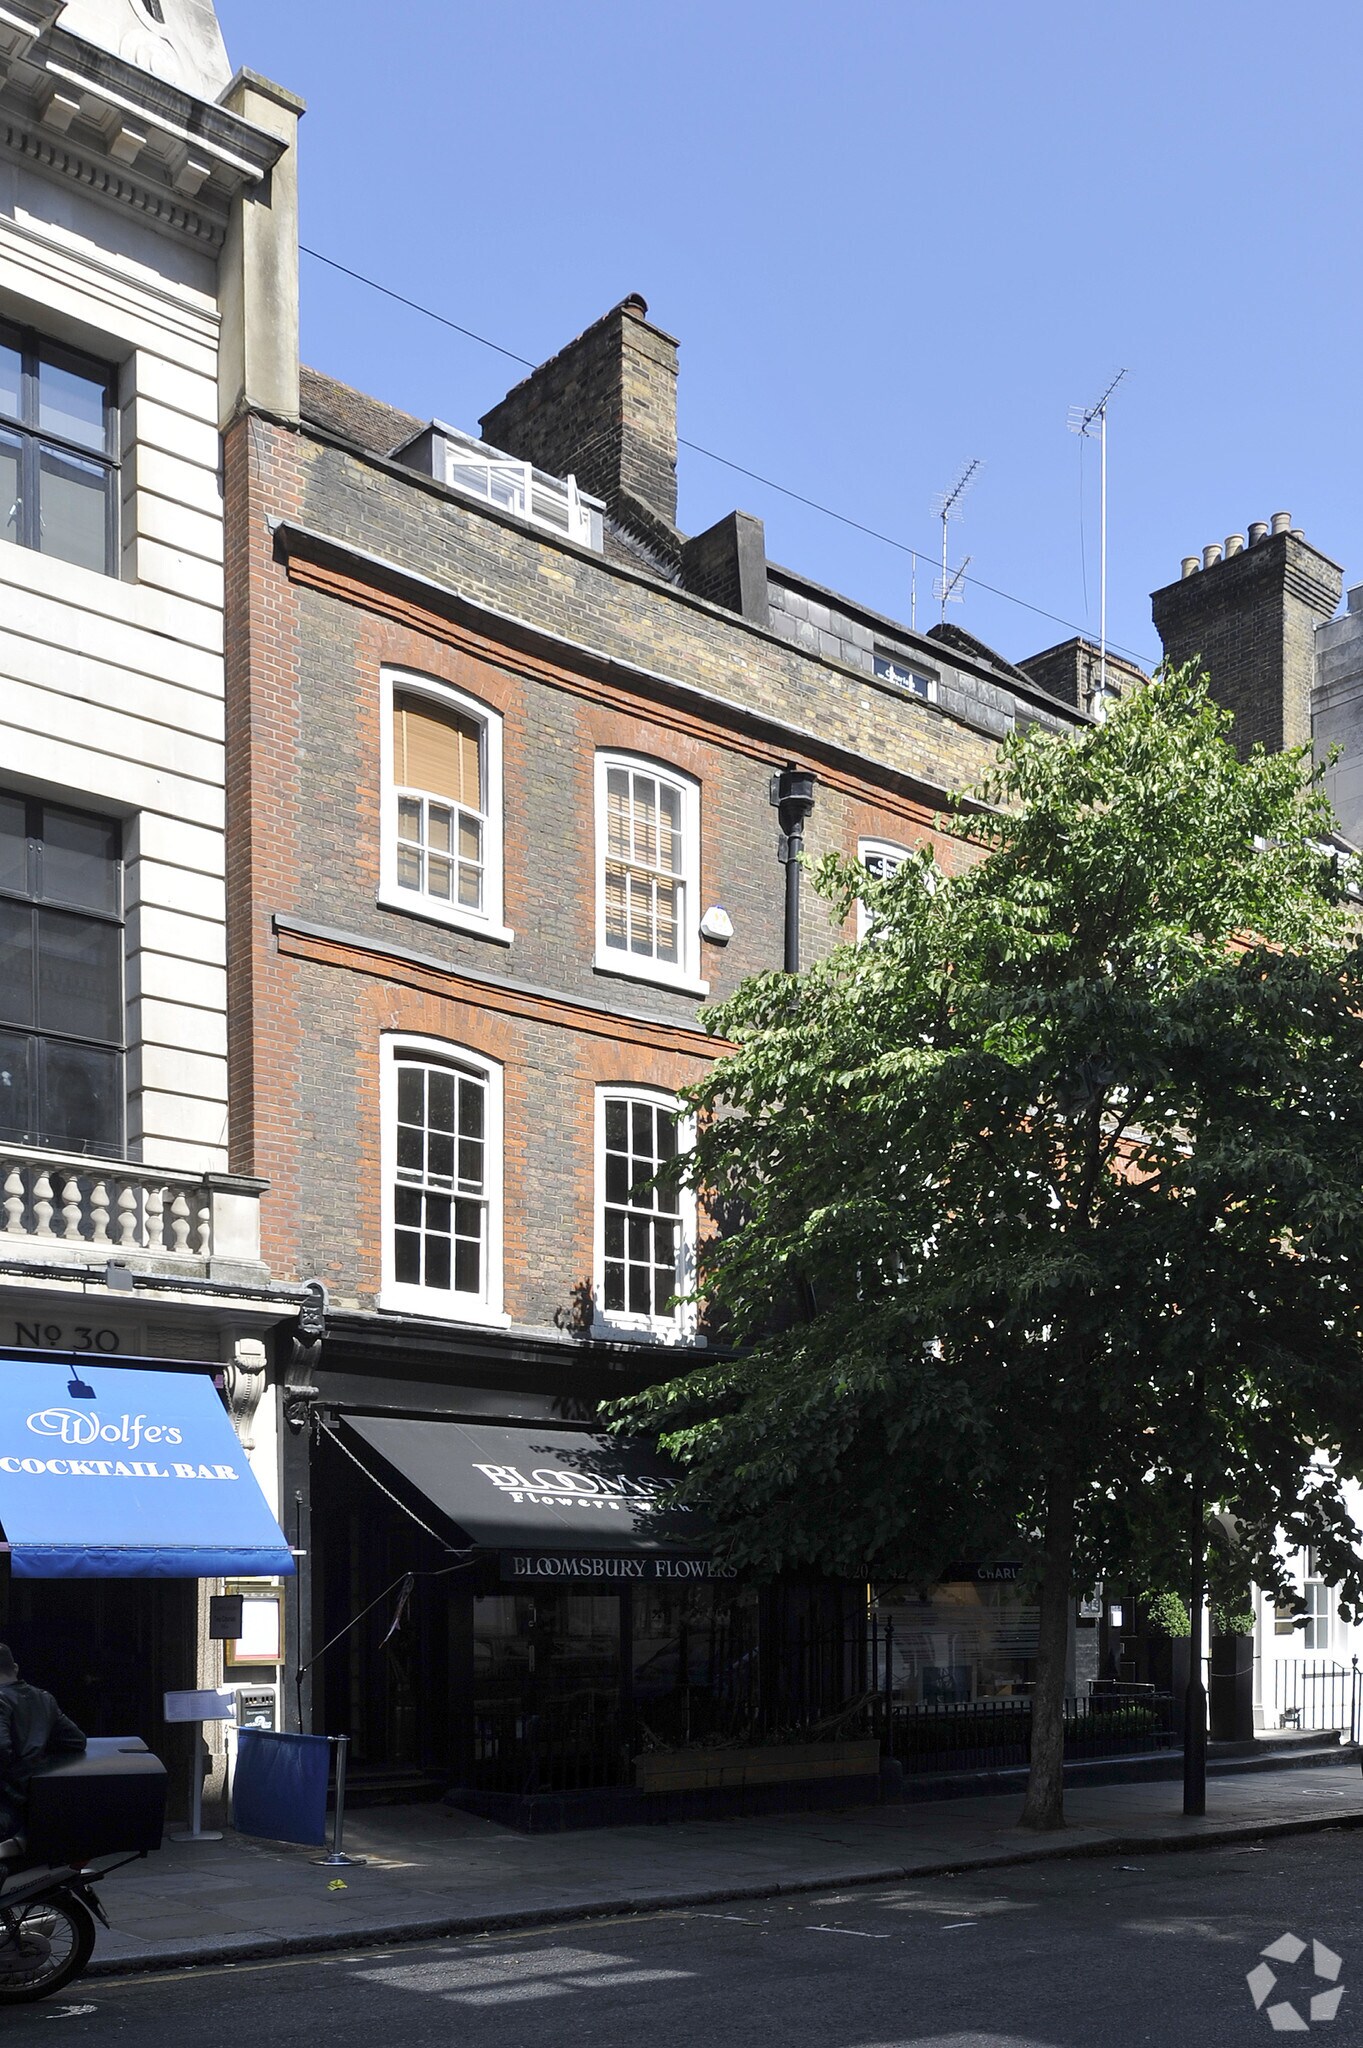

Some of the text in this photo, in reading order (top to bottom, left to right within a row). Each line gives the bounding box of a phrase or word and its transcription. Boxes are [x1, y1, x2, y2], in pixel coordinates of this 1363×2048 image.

[73, 1327, 120, 1351] 30
[26, 1407, 183, 1449] Wolfe's
[0, 1457, 239, 1480] COCKTAIL BAR
[509, 1492, 620, 1511] Flowers
[513, 1557, 738, 1578] BLOOMSBURY FLOWERS
